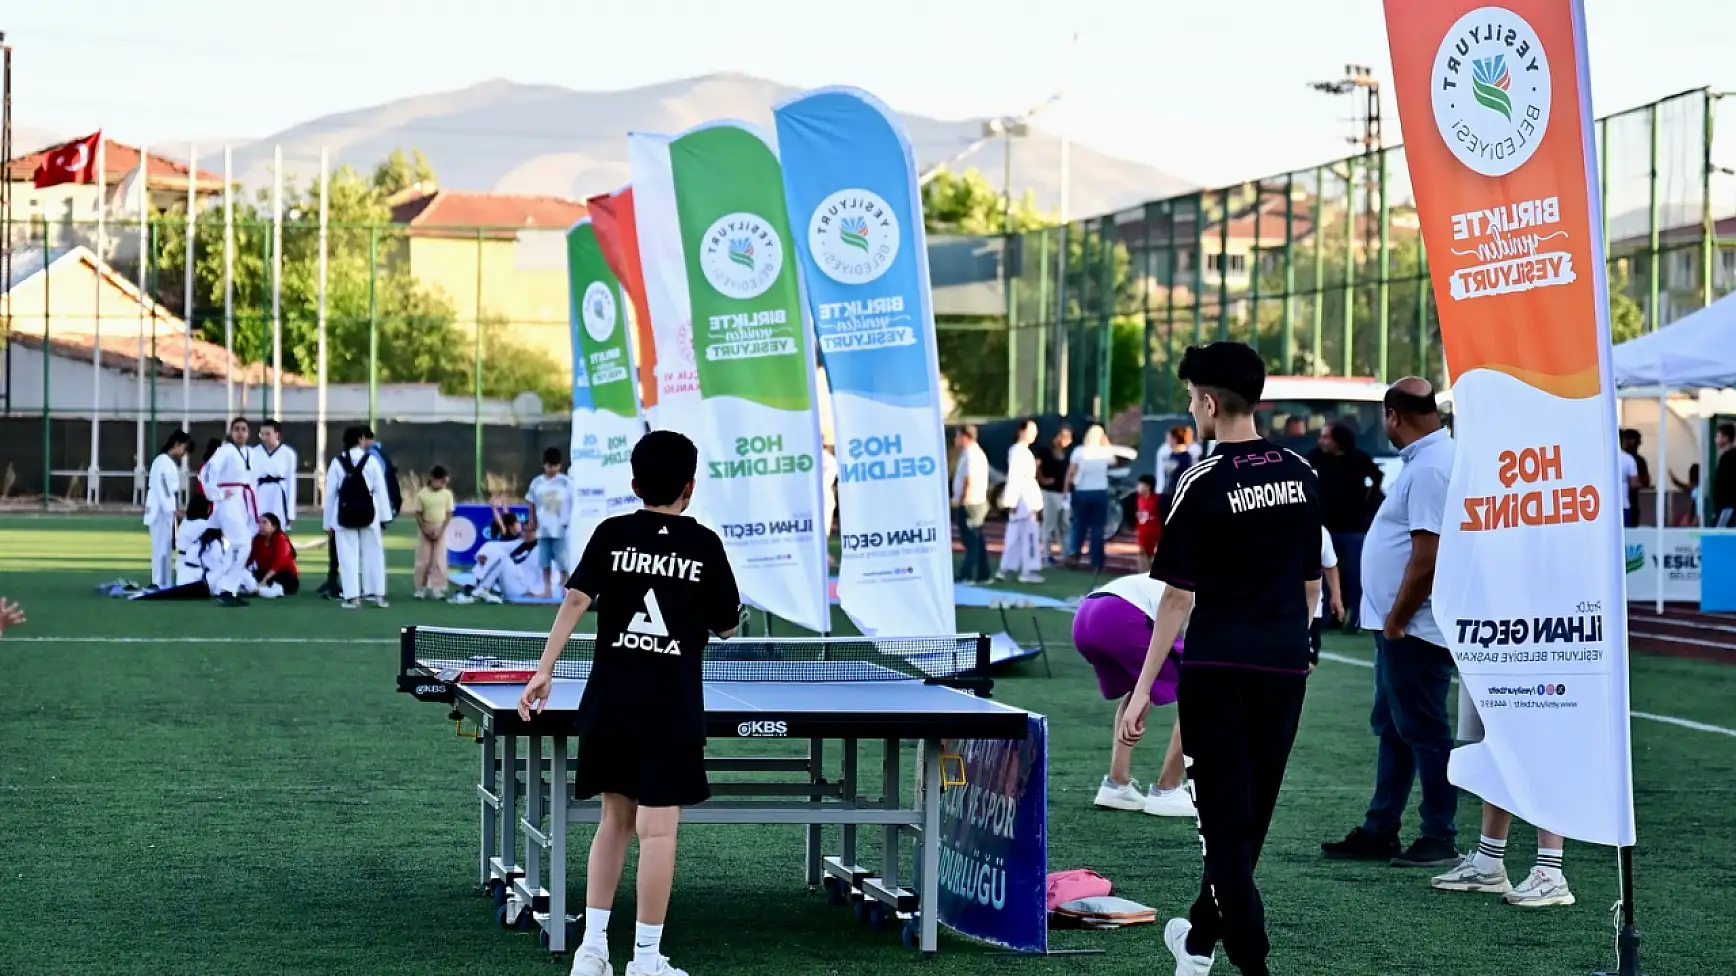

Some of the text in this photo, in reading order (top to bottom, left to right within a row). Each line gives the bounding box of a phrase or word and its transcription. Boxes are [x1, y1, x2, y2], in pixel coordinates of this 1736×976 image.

[1227, 480, 1307, 514] HİDROMEK
[611, 547, 703, 582] TÜRKİYE
[612, 632, 681, 656] JOOLA
[752, 720, 788, 734] KBS
